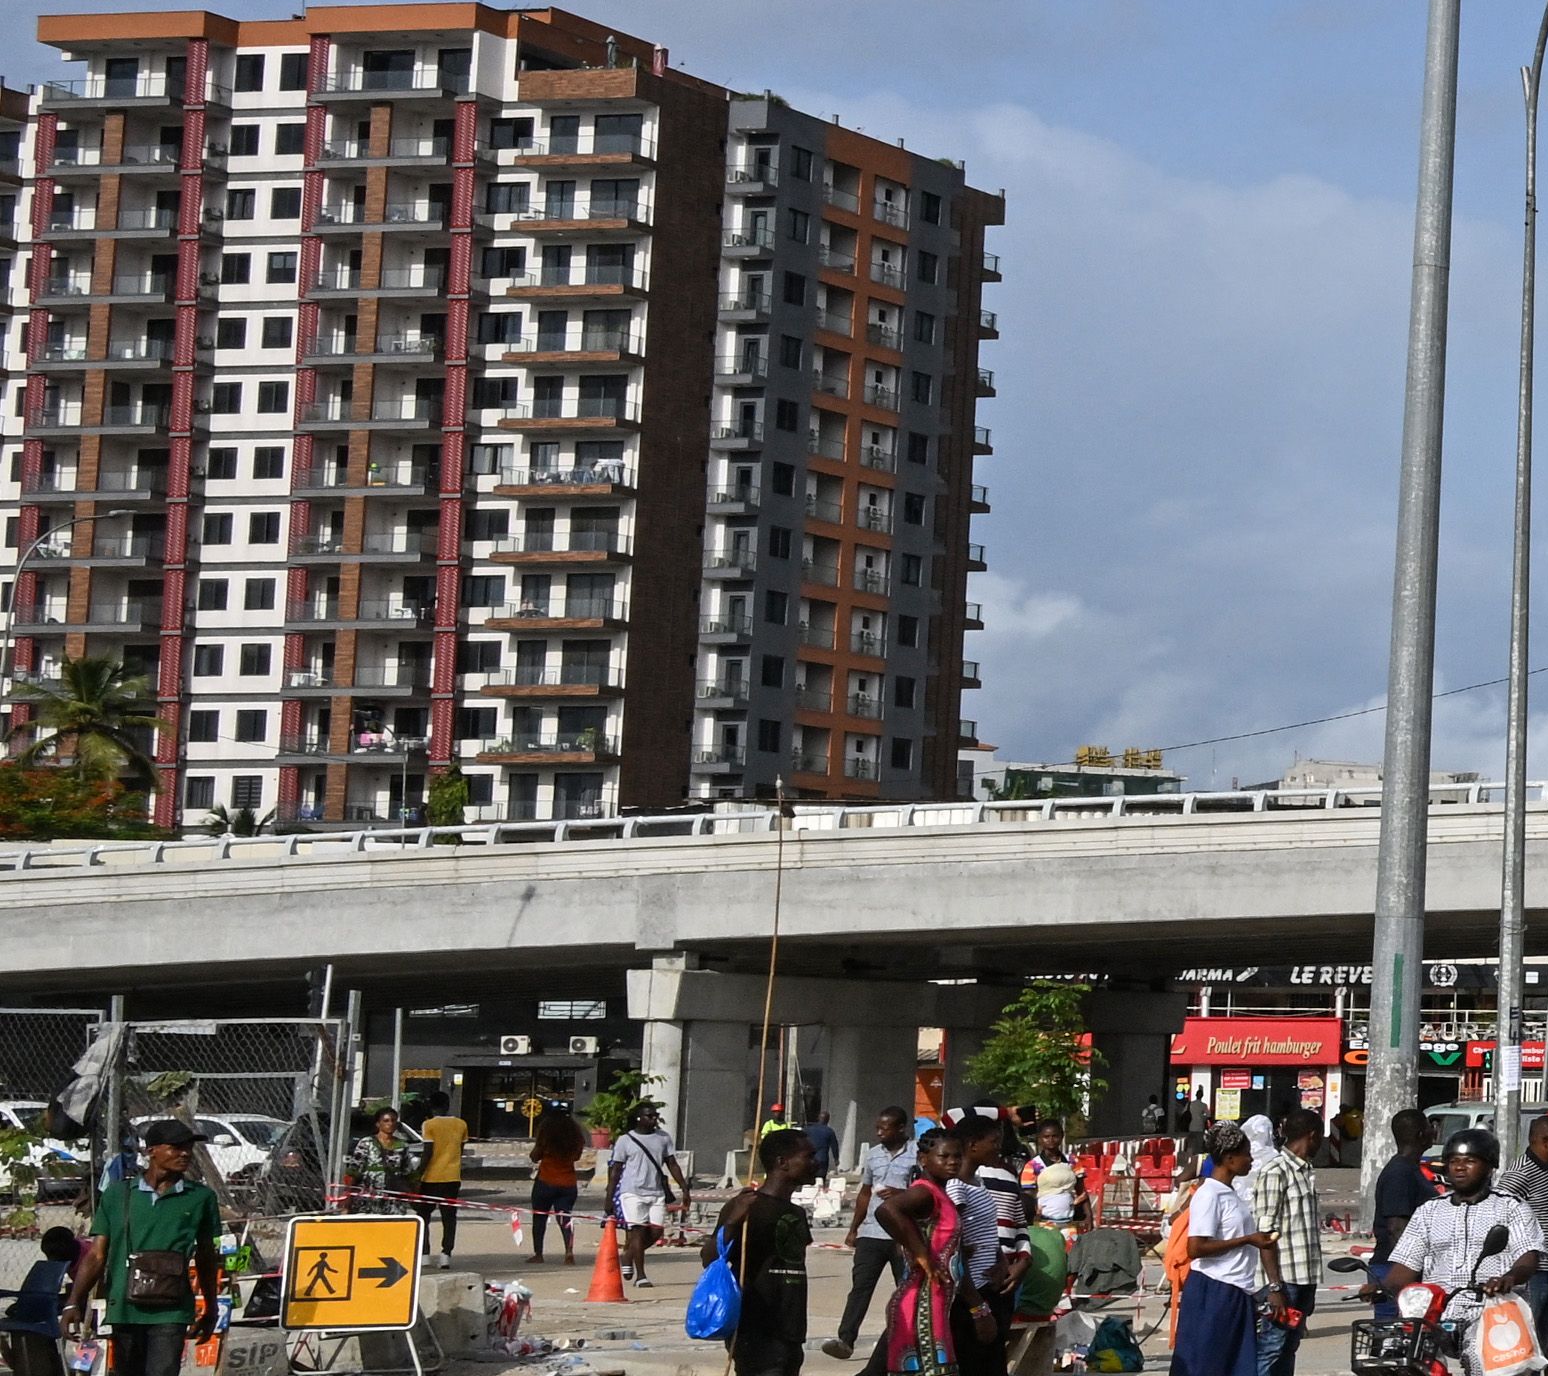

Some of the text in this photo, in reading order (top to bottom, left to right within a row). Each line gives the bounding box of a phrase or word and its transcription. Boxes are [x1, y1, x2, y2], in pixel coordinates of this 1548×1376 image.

[1290, 966, 1316, 984] LE
[1206, 1036, 1241, 1054] Poulet
[1240, 1035, 1261, 1059] frit
[1262, 1036, 1322, 1059] hamburger
[1492, 1347, 1527, 1363] casino
